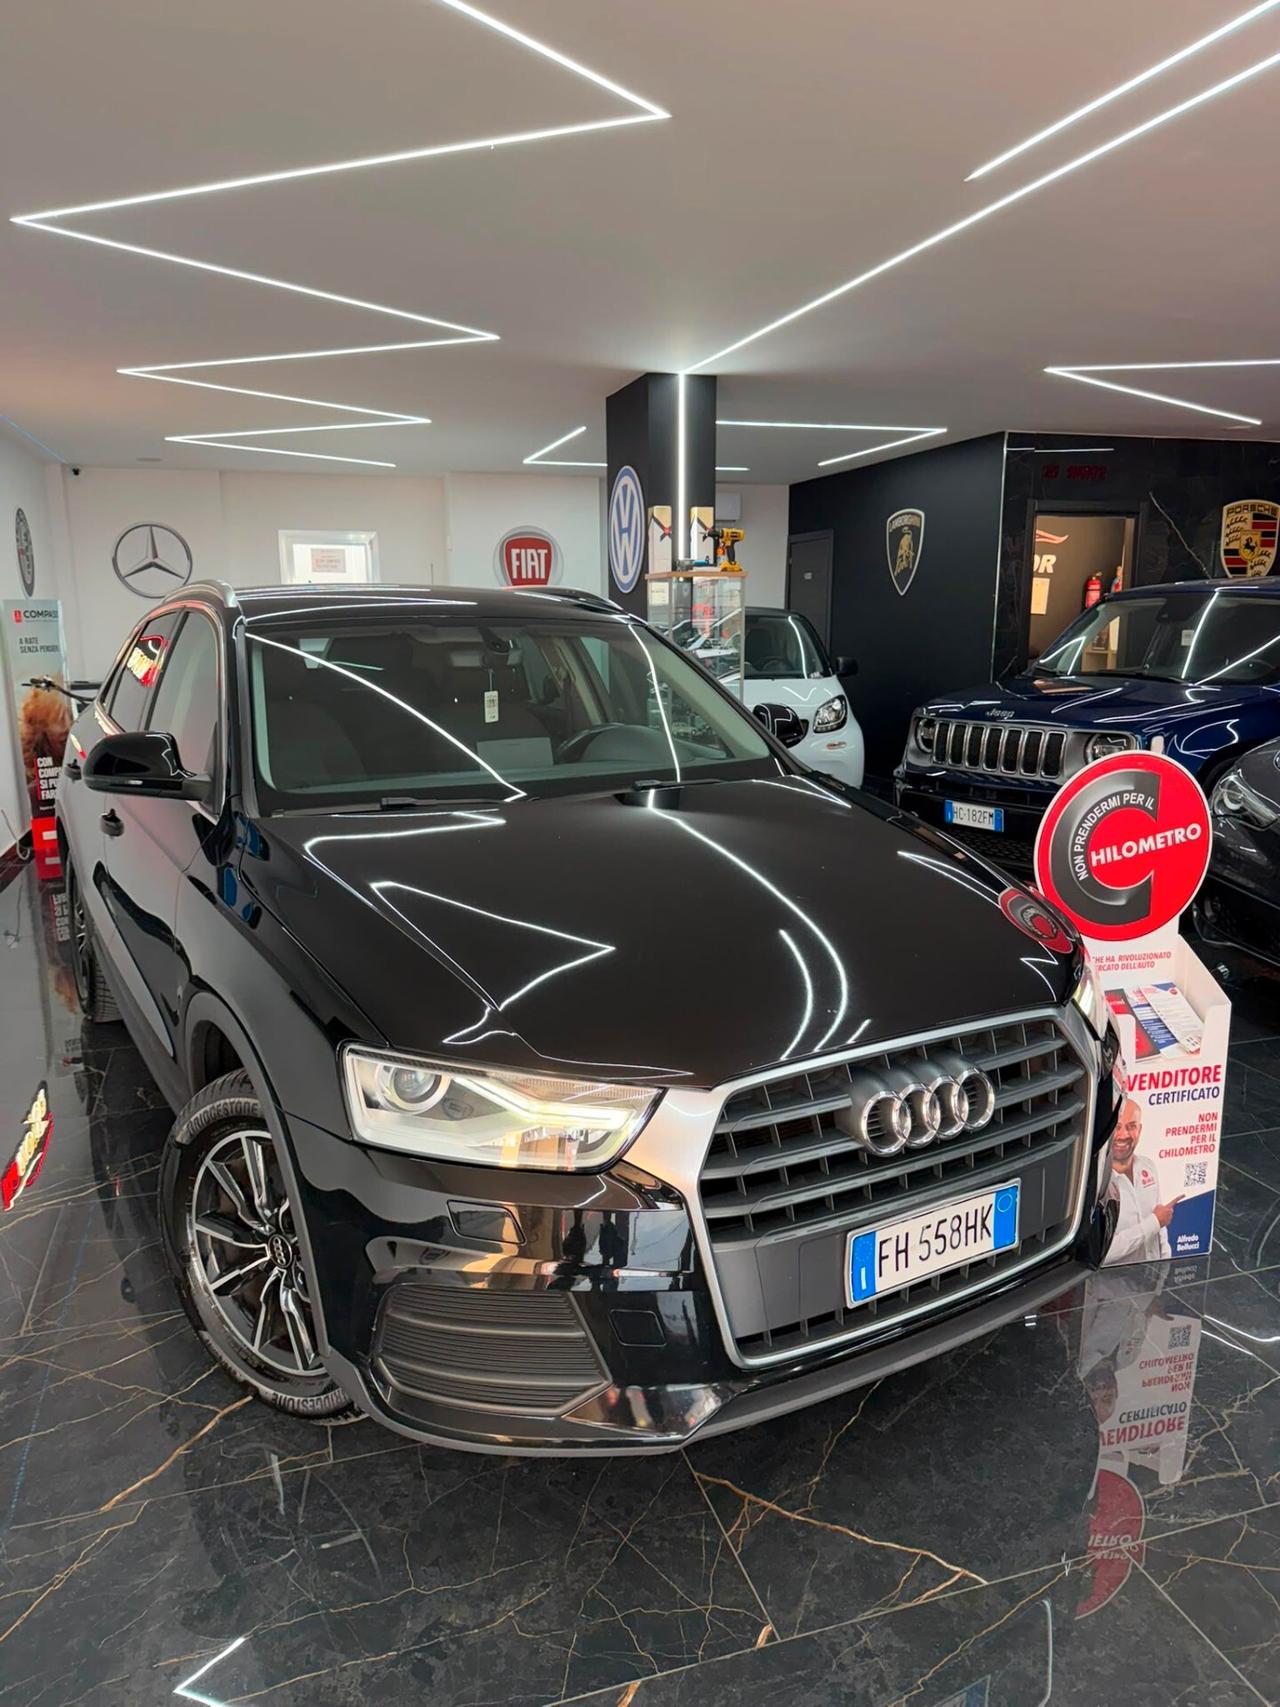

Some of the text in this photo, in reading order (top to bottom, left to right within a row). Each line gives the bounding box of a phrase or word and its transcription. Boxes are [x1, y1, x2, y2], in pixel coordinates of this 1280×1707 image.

[1226, 503, 1278, 518] PORSCHE
[511, 548, 548, 580] FIAT
[1074, 792, 1155, 881] NON PRENDERMI PER IL
[1091, 823, 1202, 868] HILOMETRO
[1105, 954, 1116, 963] HA
[1117, 951, 1172, 962] RIVOLUZIONATO
[1126, 1064, 1222, 1092] VENDITORE
[1148, 1086, 1220, 1106] CERTIFICATO
[186, 1100, 259, 1137] BRIDGESTONE
[1198, 1112, 1218, 1123] NON
[1165, 1123, 1217, 1137] PRENDERMI
[1190, 1133, 1217, 1145] PER IL
[1158, 1144, 1216, 1159] CHILOMETRO
[878, 1203, 994, 1278] FH 558HK
